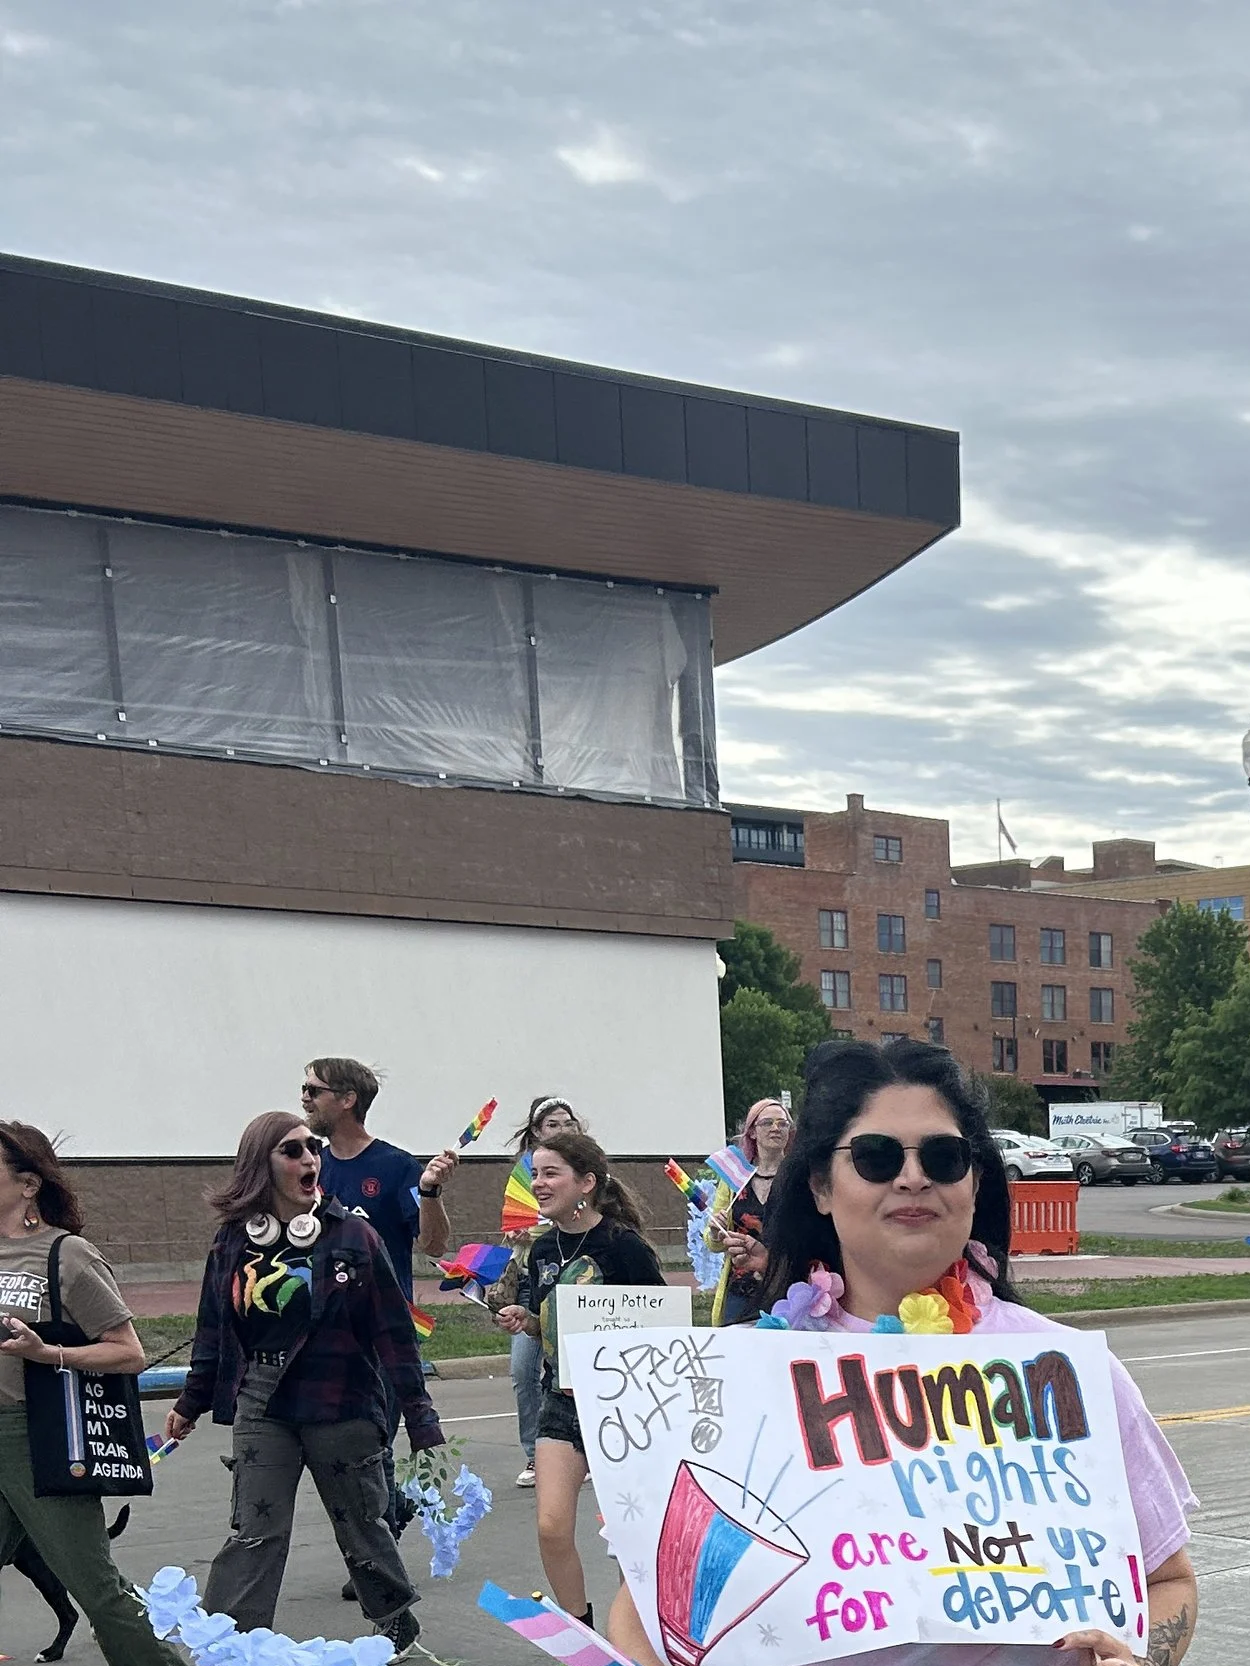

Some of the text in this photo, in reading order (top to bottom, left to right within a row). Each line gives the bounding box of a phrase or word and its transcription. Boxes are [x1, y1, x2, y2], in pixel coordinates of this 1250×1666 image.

[0, 1275, 40, 1292] EOPLE
[577, 1293, 664, 1315] Harry Potter
[593, 1320, 644, 1331] nobod
[85, 1400, 127, 1419] HLDS
[92, 1462, 144, 1479] AGENDA
[890, 1445, 1092, 1527] rights
[831, 1531, 928, 1571] are
[1046, 1526, 1107, 1567] up
[805, 1581, 895, 1642] for
